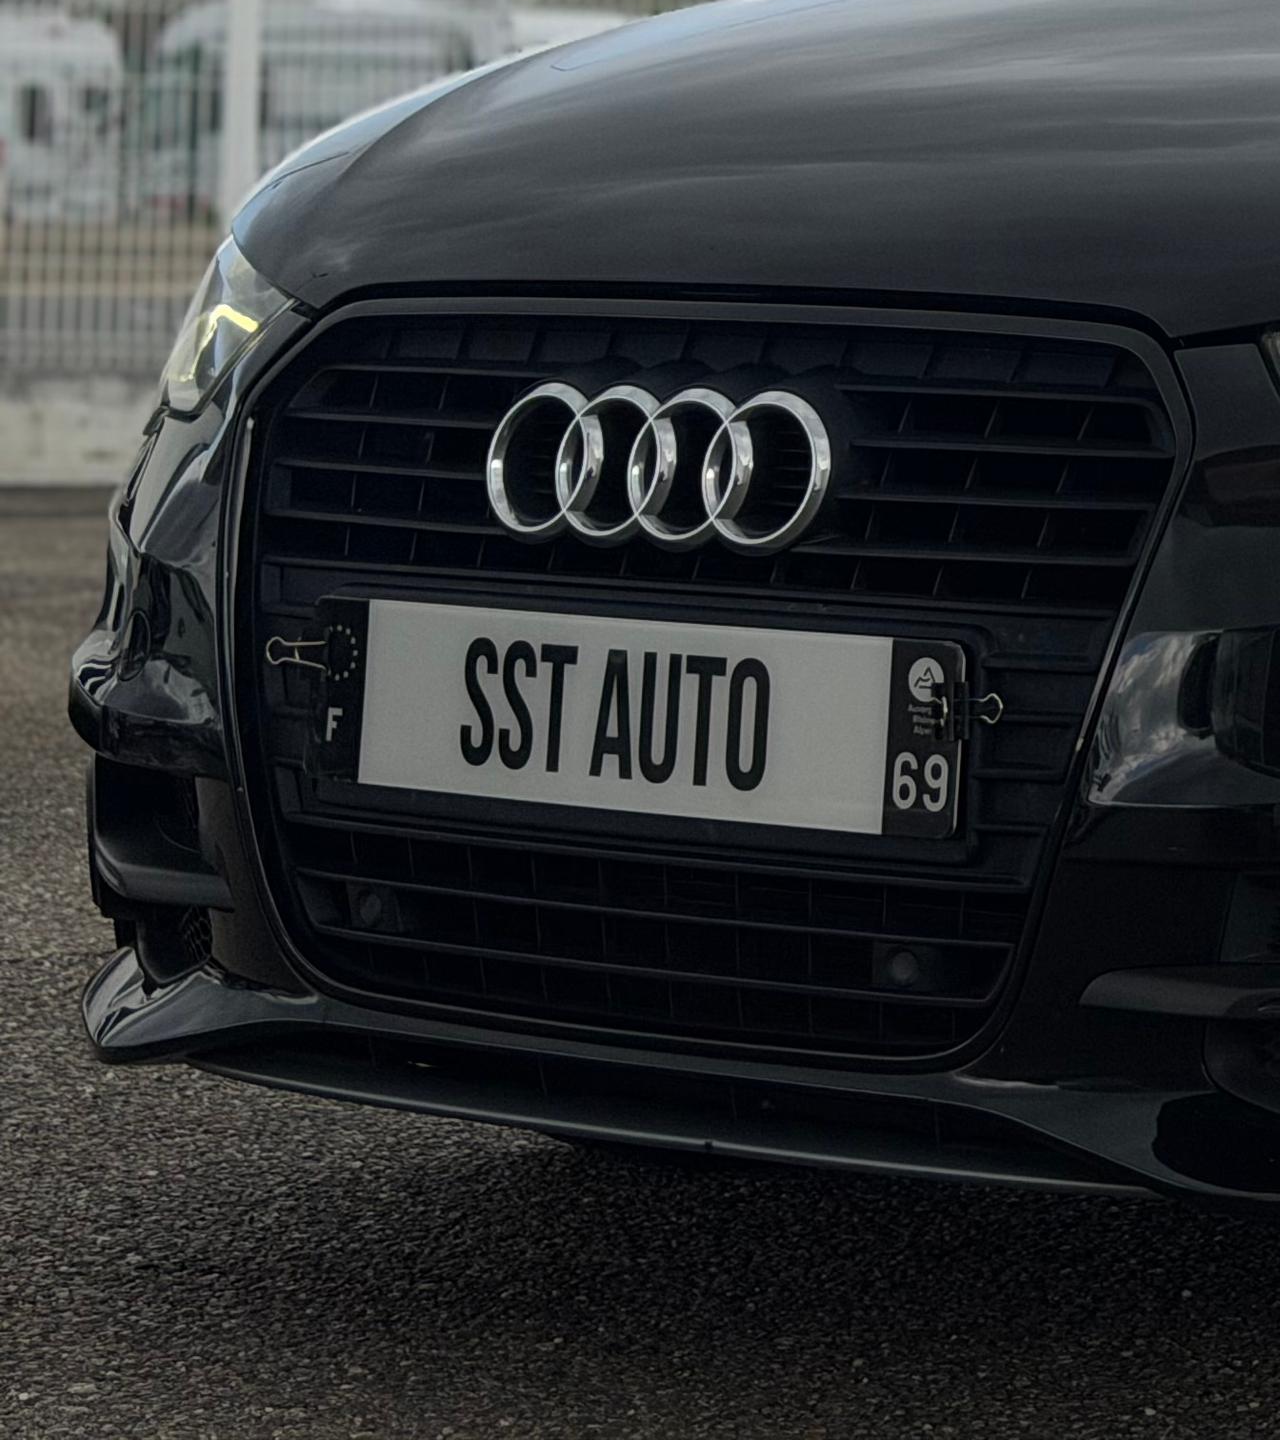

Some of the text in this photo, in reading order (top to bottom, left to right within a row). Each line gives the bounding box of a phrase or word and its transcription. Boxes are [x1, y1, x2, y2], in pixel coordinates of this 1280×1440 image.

[326, 707, 343, 742] F
[460, 637, 770, 791] SST AUTO
[892, 751, 948, 812] 69
